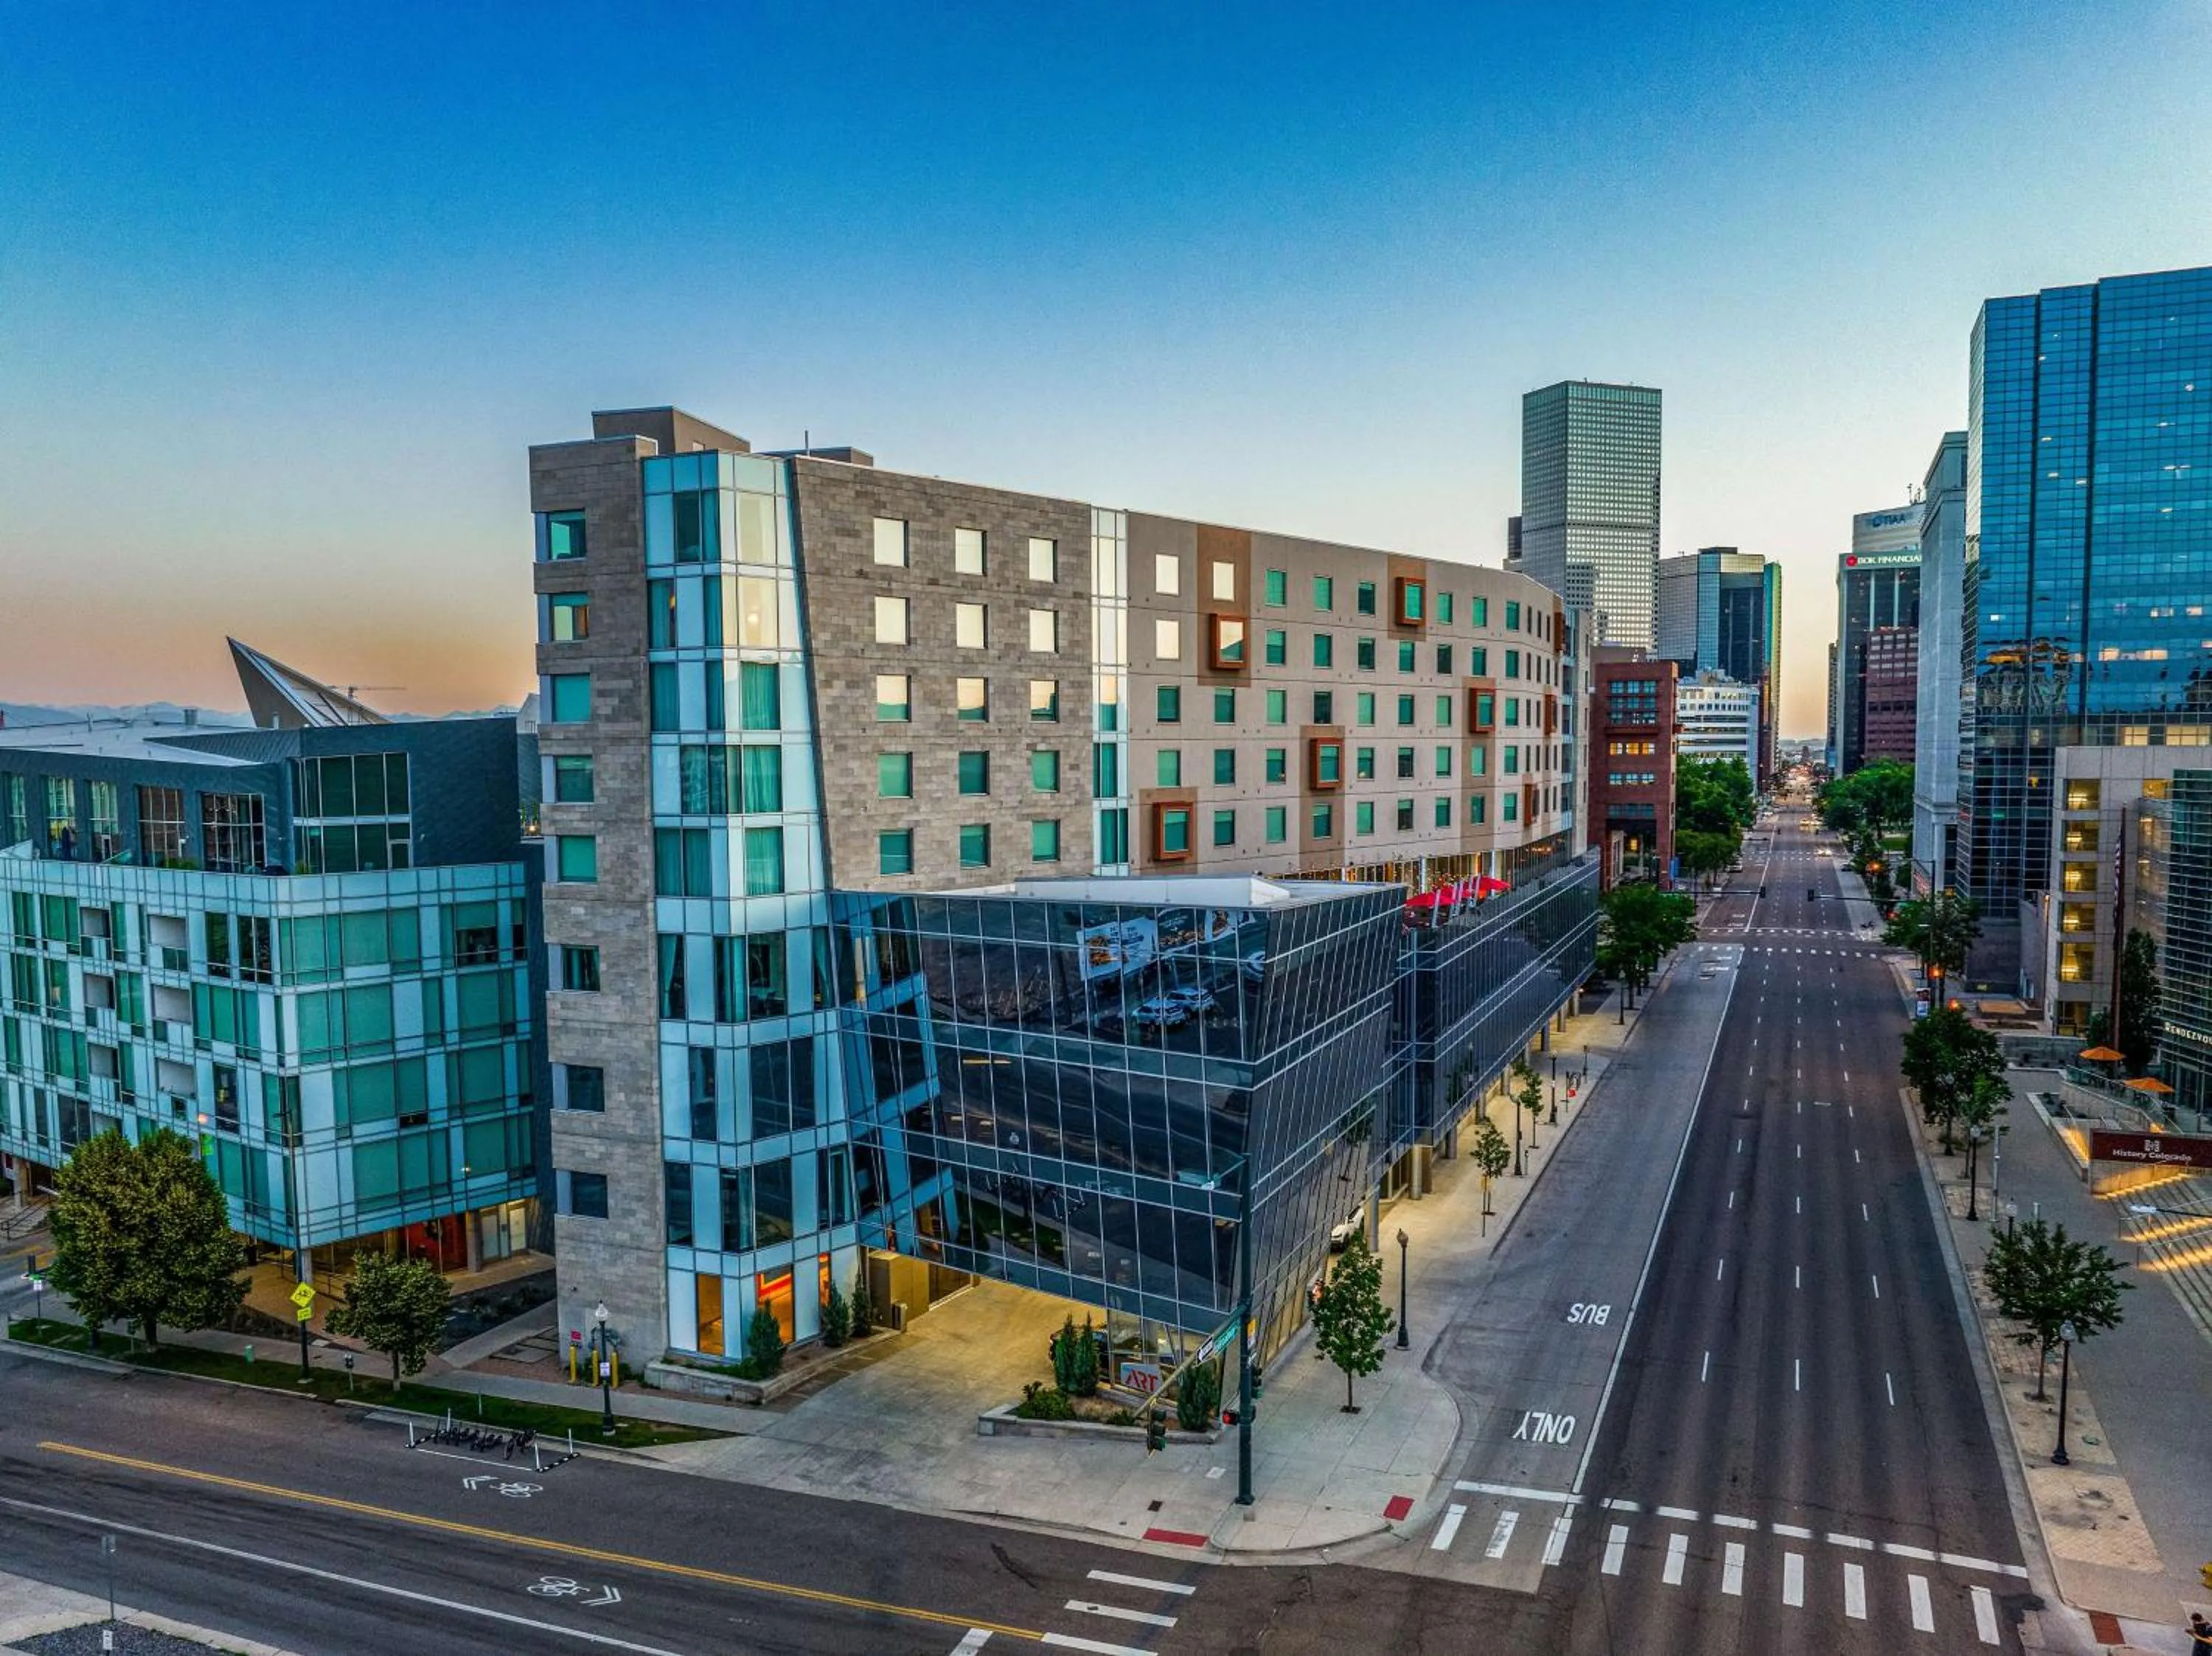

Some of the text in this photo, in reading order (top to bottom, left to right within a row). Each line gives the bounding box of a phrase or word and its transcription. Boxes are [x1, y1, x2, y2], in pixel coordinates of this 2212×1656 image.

[1857, 556, 1877, 564] BOK
[2112, 1149, 2193, 1161] History Colorado
[1567, 1303, 1610, 1326] BUS
[1125, 1368, 1158, 1392] ART
[1512, 1411, 1576, 1444] ONLY
